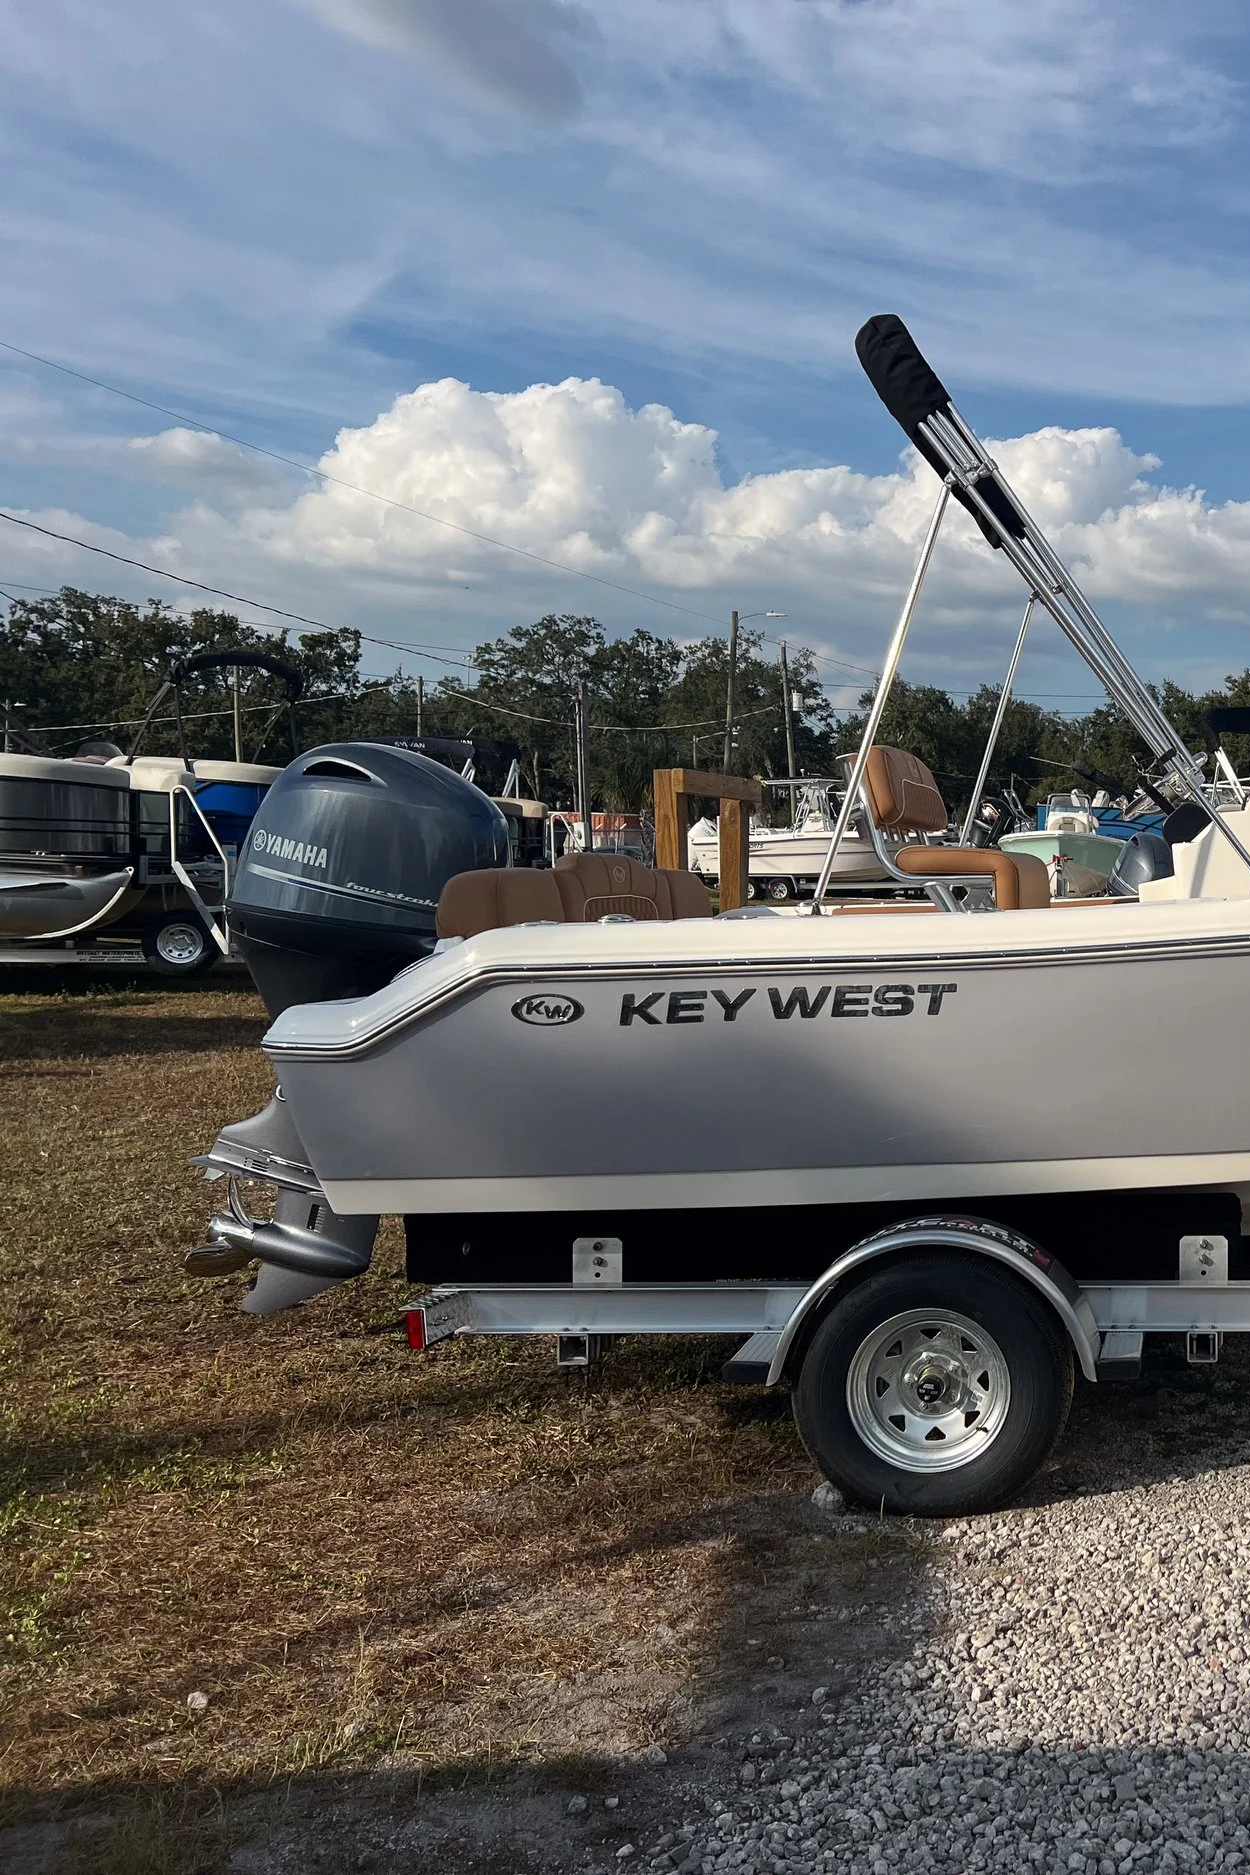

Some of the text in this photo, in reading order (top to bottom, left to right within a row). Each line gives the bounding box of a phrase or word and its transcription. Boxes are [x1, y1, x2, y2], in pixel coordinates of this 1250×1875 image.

[265, 833, 328, 869] YAMAHA
[525, 1000, 572, 1020] KW
[618, 983, 958, 1027] KEY WEST
